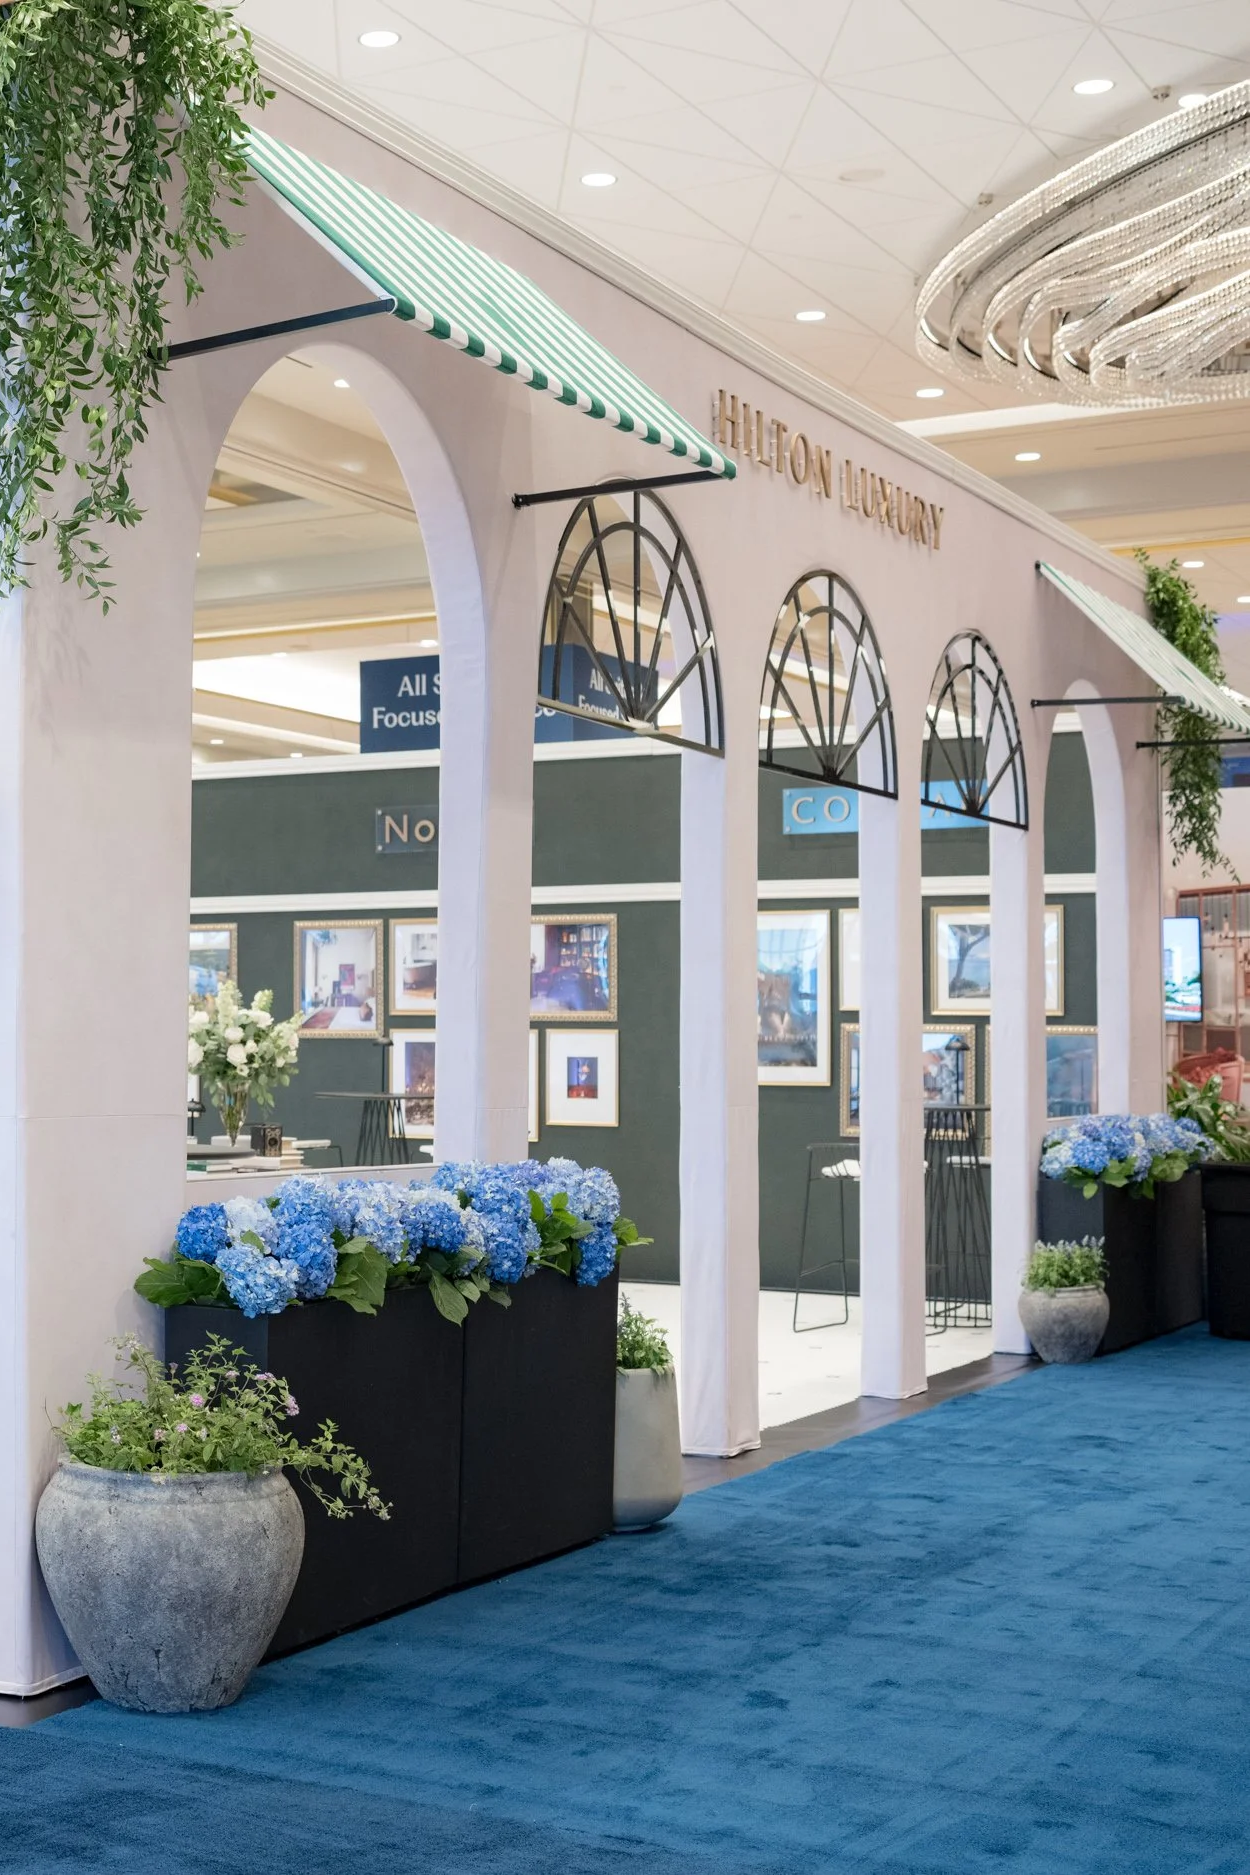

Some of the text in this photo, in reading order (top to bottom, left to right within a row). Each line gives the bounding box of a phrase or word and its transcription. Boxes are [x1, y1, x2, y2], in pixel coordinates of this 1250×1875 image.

[717, 388, 944, 550] HILTON LUXURY
[397, 673, 427, 698] All
[791, 796, 849, 824] CO
[384, 814, 435, 843] No
